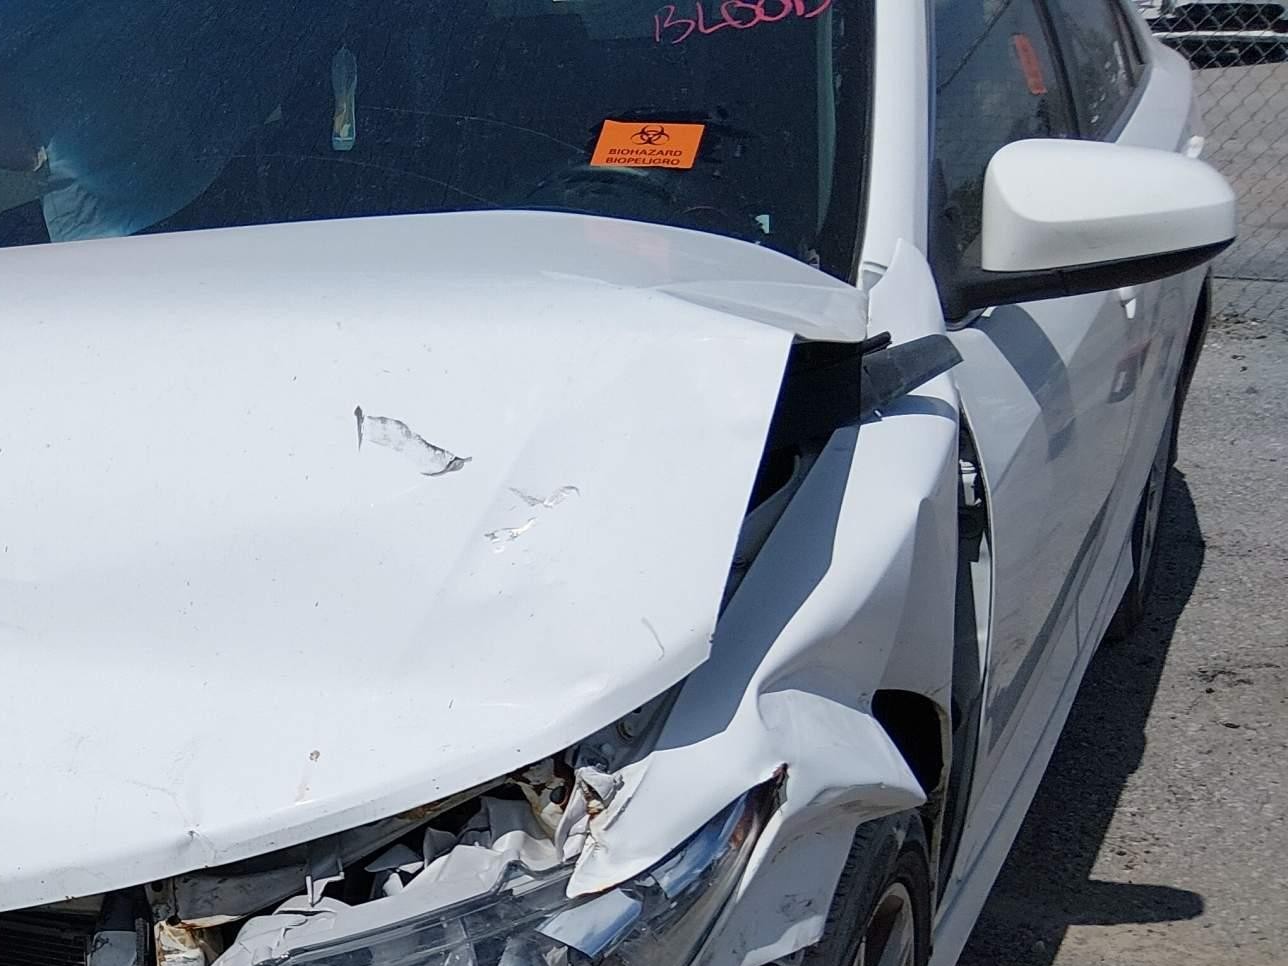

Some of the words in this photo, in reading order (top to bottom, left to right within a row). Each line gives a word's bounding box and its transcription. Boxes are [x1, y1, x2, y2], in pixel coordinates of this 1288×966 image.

[654, 0, 832, 44] BLOOD
[607, 148, 683, 157] BIOHAZARD
[605, 157, 681, 166] BIOPELIGRO
